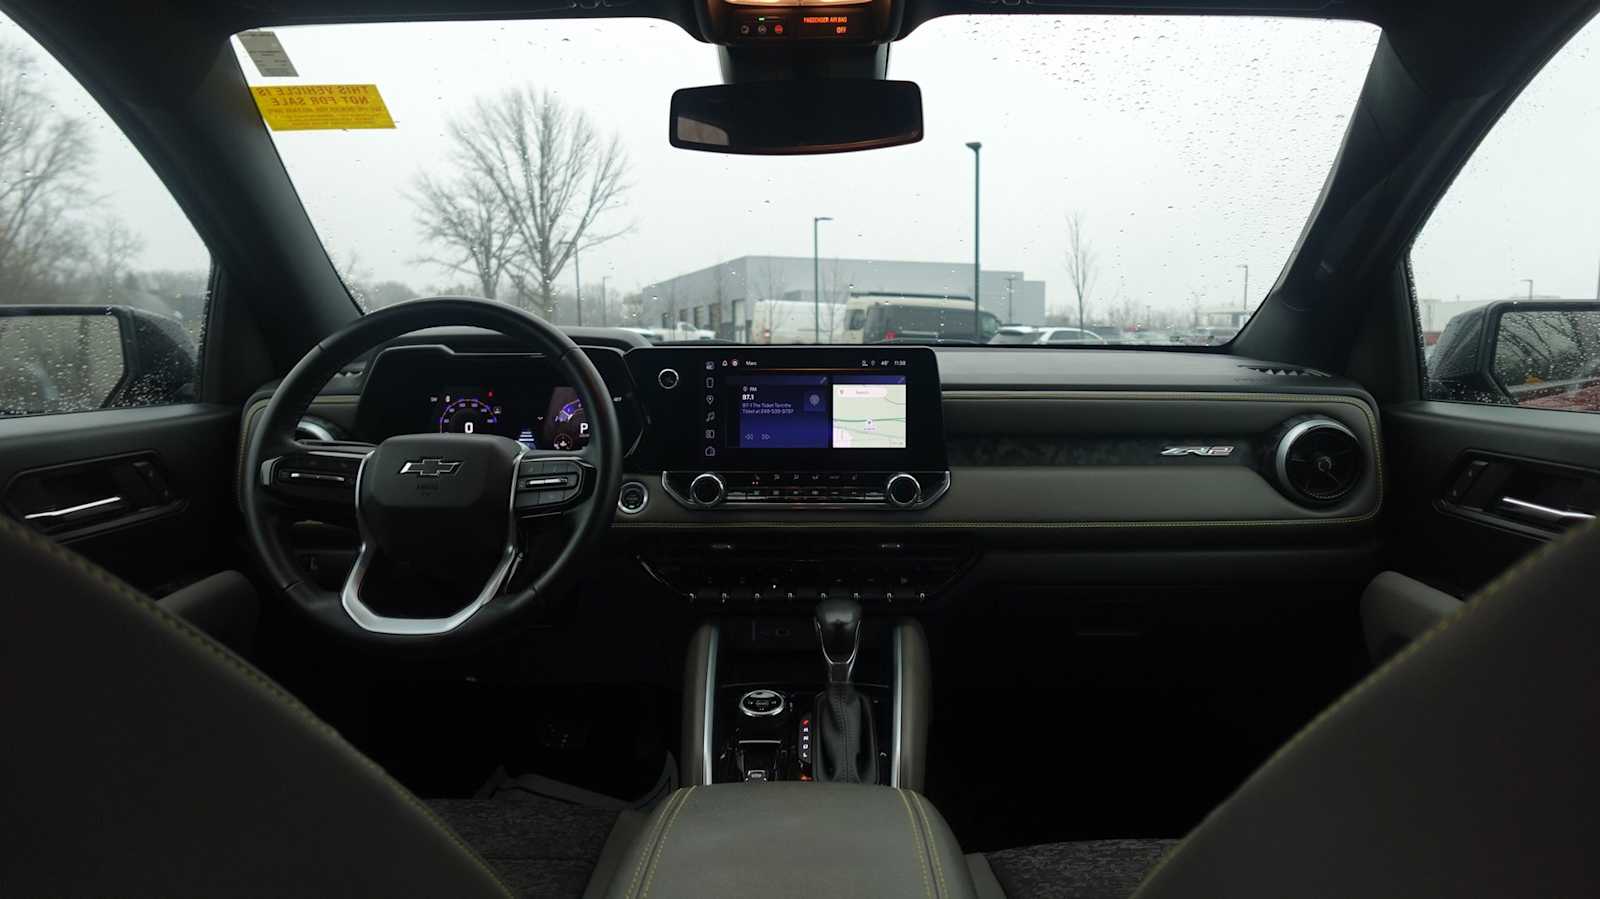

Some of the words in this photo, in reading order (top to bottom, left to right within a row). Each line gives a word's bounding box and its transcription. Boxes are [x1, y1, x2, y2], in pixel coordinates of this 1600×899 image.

[836, 26, 846, 34] OFF
[464, 422, 473, 433] 0
[580, 422, 589, 434] P
[1160, 446, 1235, 456] ZR2
